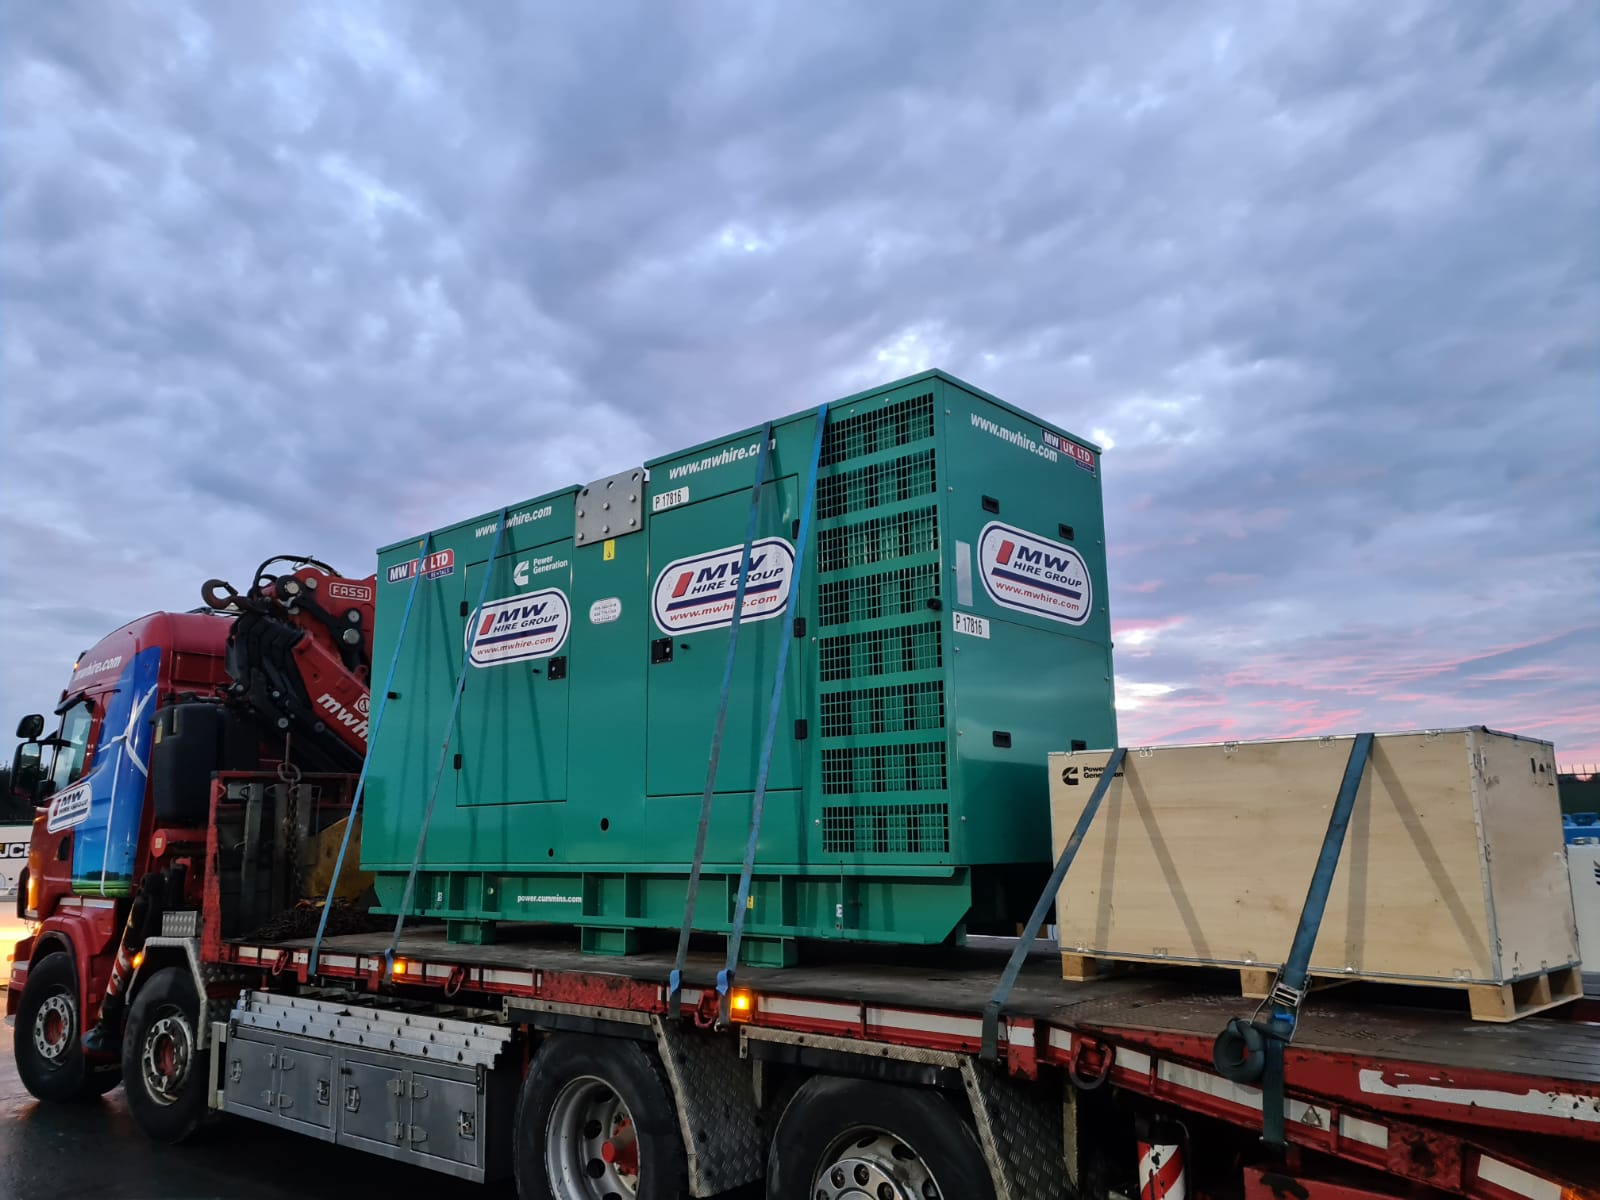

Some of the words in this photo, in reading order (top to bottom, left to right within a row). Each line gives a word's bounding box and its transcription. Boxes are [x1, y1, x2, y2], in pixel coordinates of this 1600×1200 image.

[971, 413, 1057, 463] www.mwhire.com
[1044, 431, 1060, 448] MW
[1062, 441, 1074, 456] UK
[1077, 448, 1090, 462] LTD
[655, 496, 660, 509] P
[662, 490, 681, 507] 17816
[390, 564, 408, 581] MW
[430, 552, 448, 568] LTD
[533, 555, 553, 566] Power
[533, 559, 568, 574] Generation
[1017, 545, 1070, 572] MW
[696, 554, 767, 583] MW
[1013, 561, 1042, 576] HIRE
[1044, 571, 1082, 588] GROUP
[333, 585, 368, 598] FASSI
[691, 580, 727, 595] HIRE
[996, 582, 1079, 611] www.mwhire.com
[497, 602, 548, 624] MW
[956, 614, 960, 630] P
[493, 622, 518, 633] HIRE
[521, 614, 560, 628] GROUP
[477, 637, 554, 656] www.mwhire.com
[316, 693, 368, 742] mwh
[61, 789, 84, 806] MW
[517, 893, 582, 904] power.cummins.com
